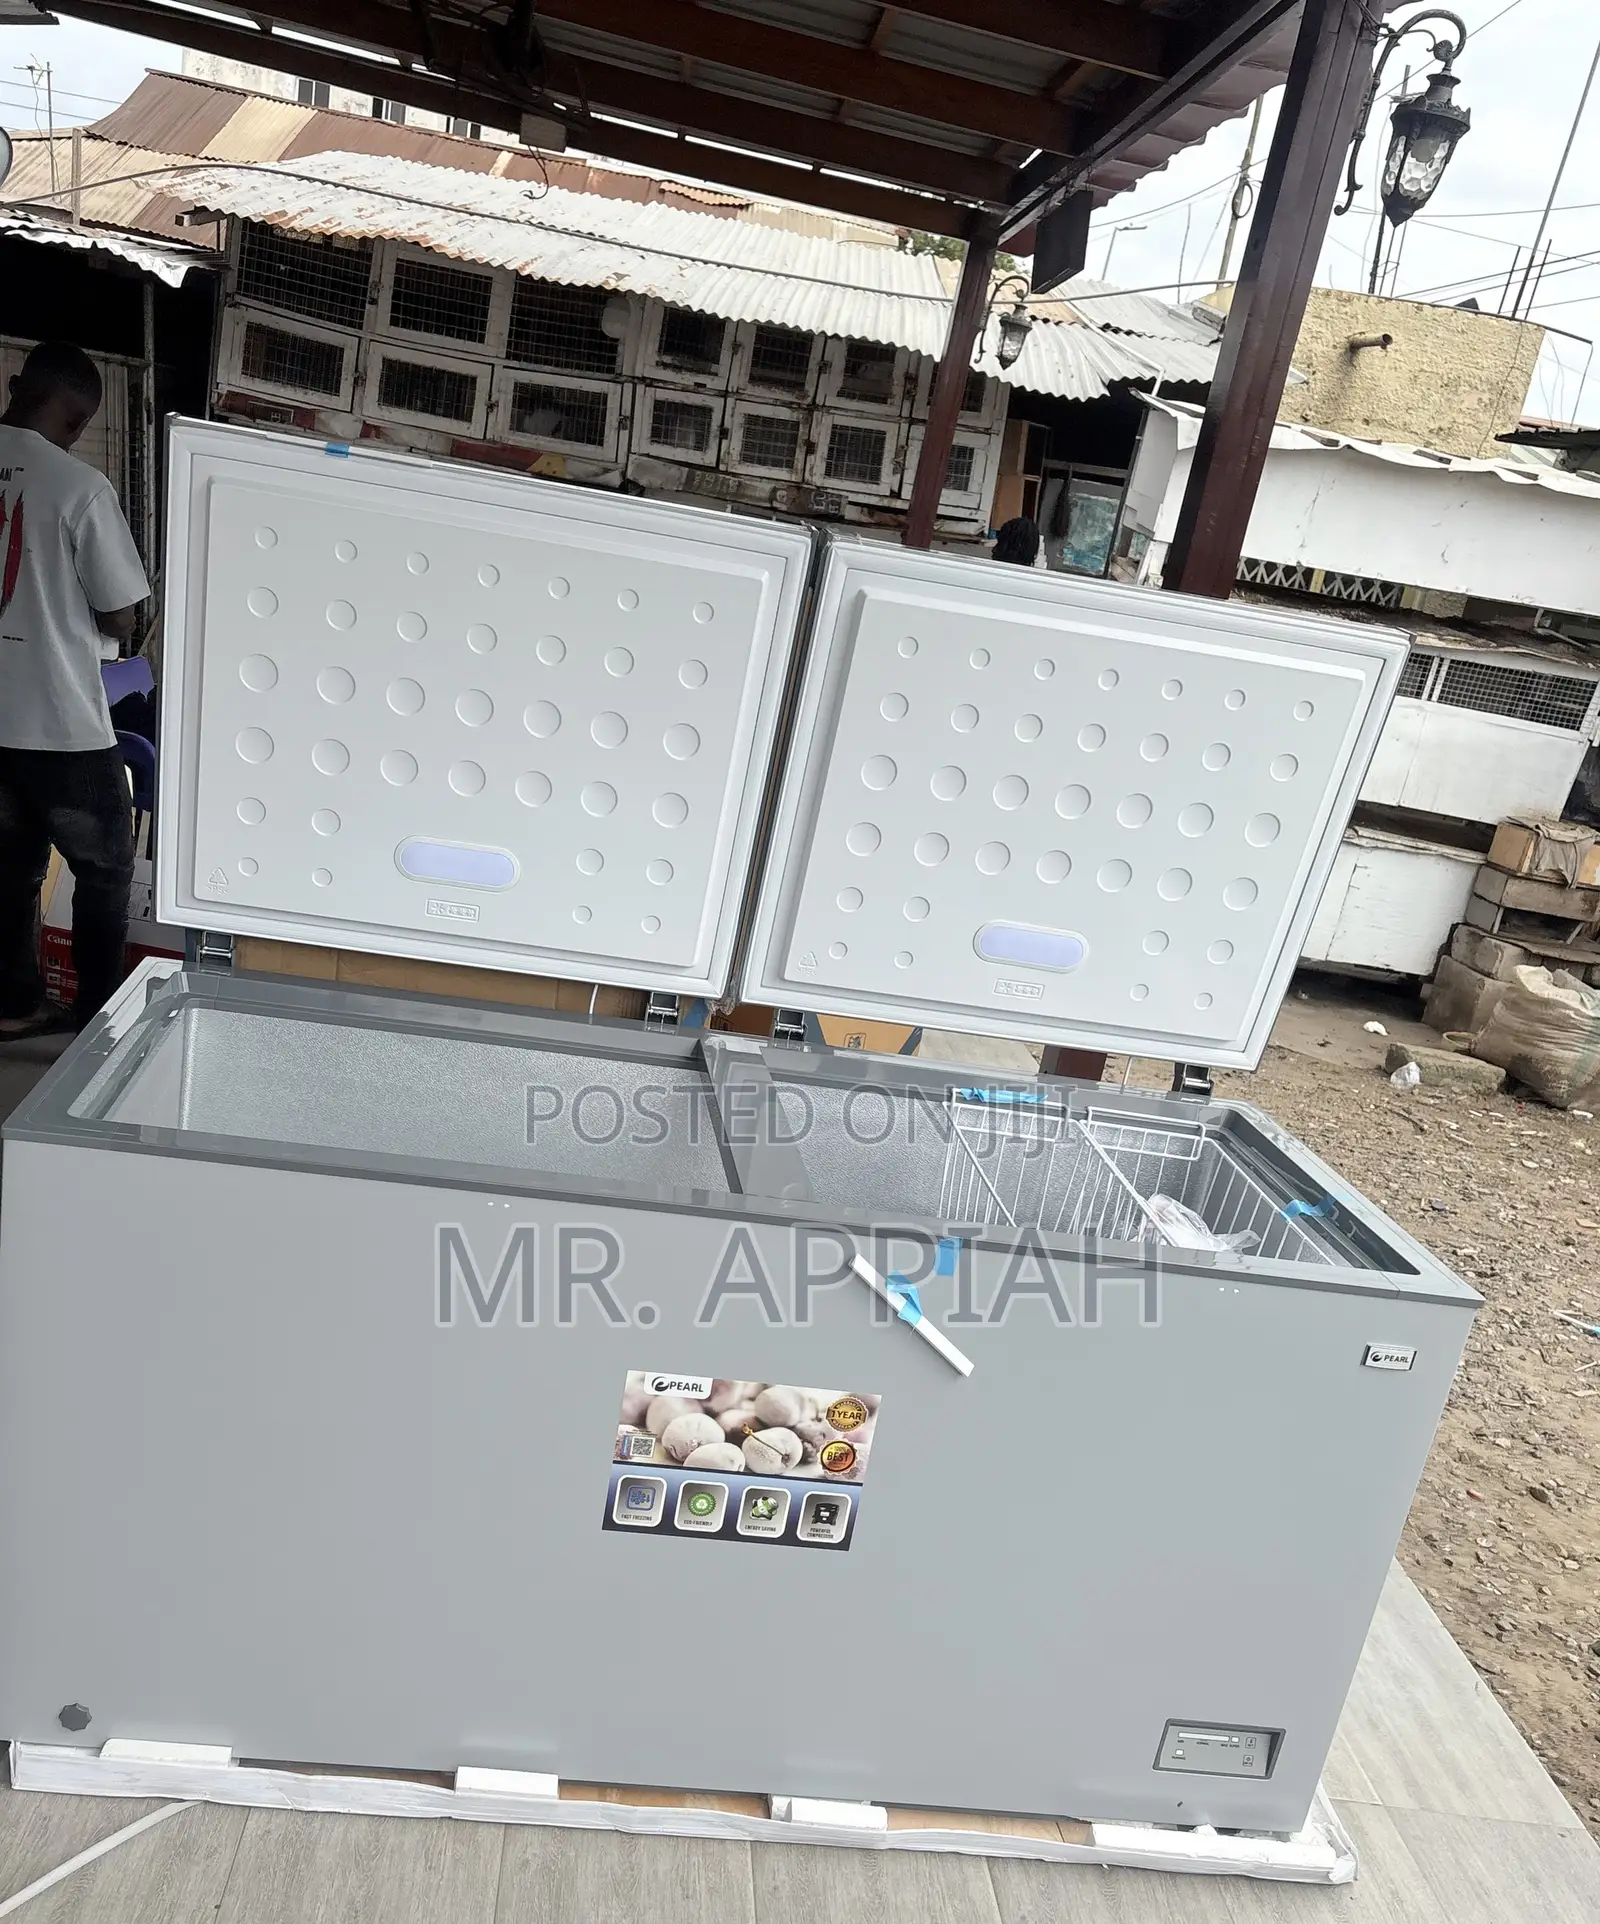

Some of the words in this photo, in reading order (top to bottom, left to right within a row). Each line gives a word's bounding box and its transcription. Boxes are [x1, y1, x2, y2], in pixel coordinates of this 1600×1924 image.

[1384, 1355, 1409, 1363] PEARL
[669, 1381, 704, 1392] PEARL
[837, 1411, 862, 1420] YEAR
[827, 1452, 850, 1462] BEST
